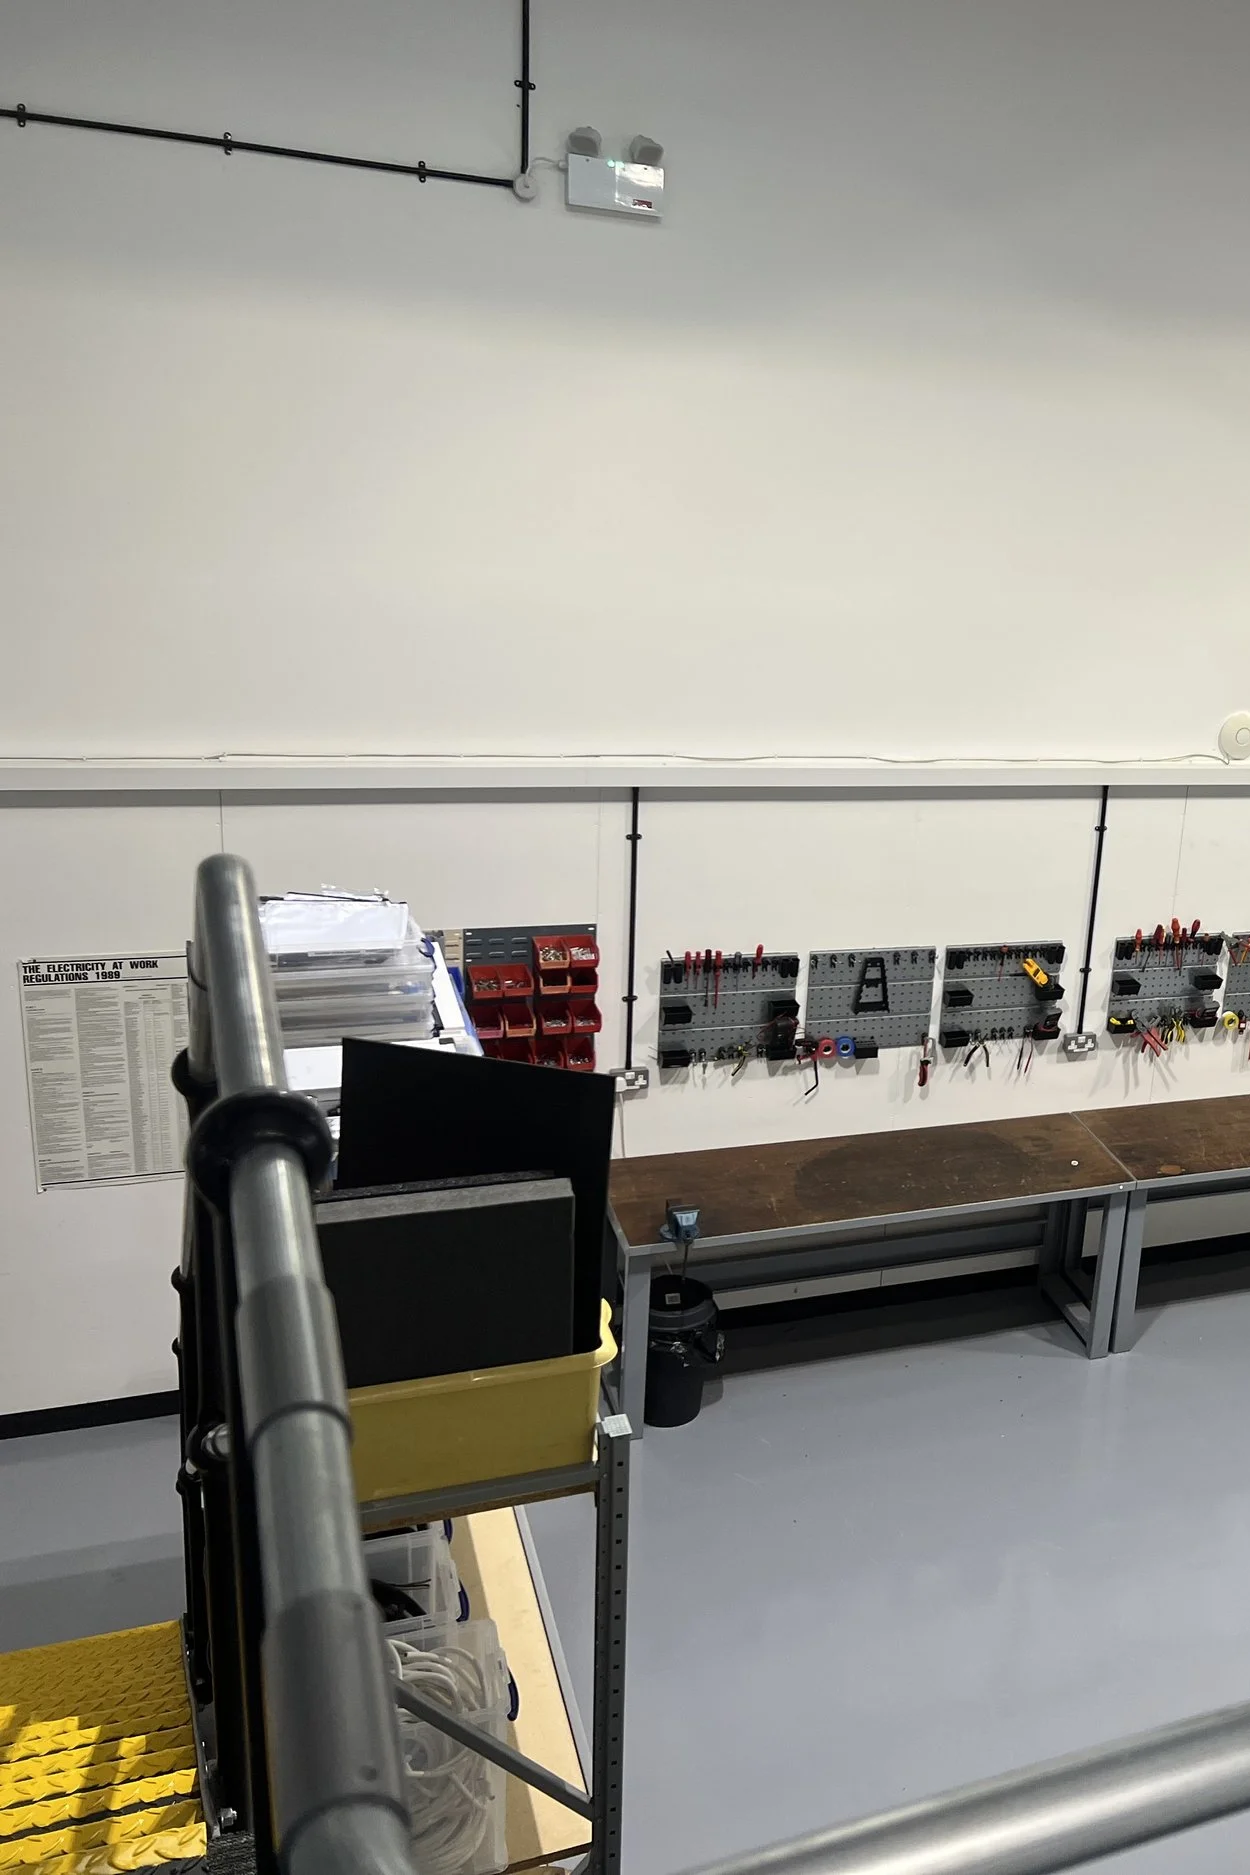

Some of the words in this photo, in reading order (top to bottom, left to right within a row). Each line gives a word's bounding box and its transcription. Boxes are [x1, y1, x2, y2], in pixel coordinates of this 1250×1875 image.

[22, 964, 41, 974] THE
[46, 961, 106, 973] ELECTRICITY
[112, 961, 123, 970] AT
[129, 960, 159, 969] WORK
[22, 972, 89, 984] REGULATIONS
[95, 970, 121, 980] 1989
